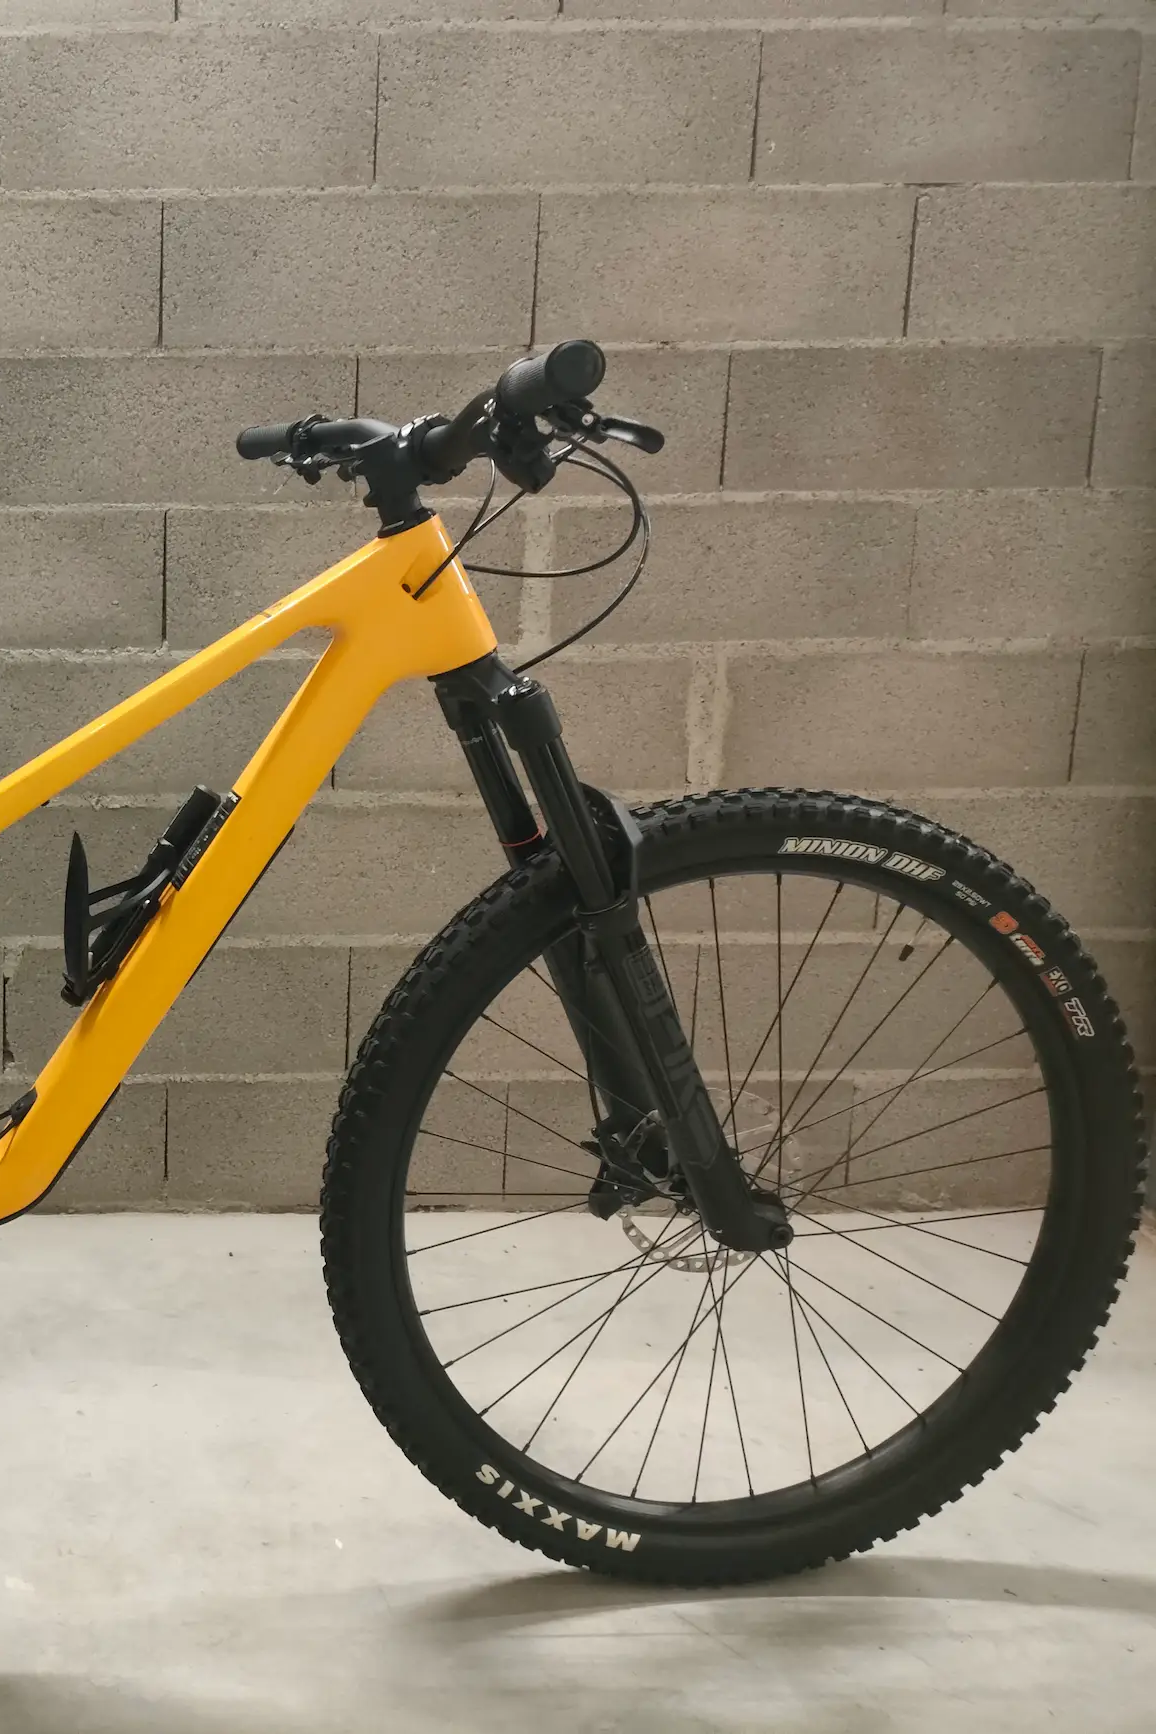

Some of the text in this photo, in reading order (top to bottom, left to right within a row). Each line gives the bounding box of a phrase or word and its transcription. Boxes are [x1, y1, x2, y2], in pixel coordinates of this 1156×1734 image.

[778, 837, 946, 881] MINION DHF
[1064, 997, 1095, 1036] TR
[475, 1463, 641, 1552] MAXXIS
